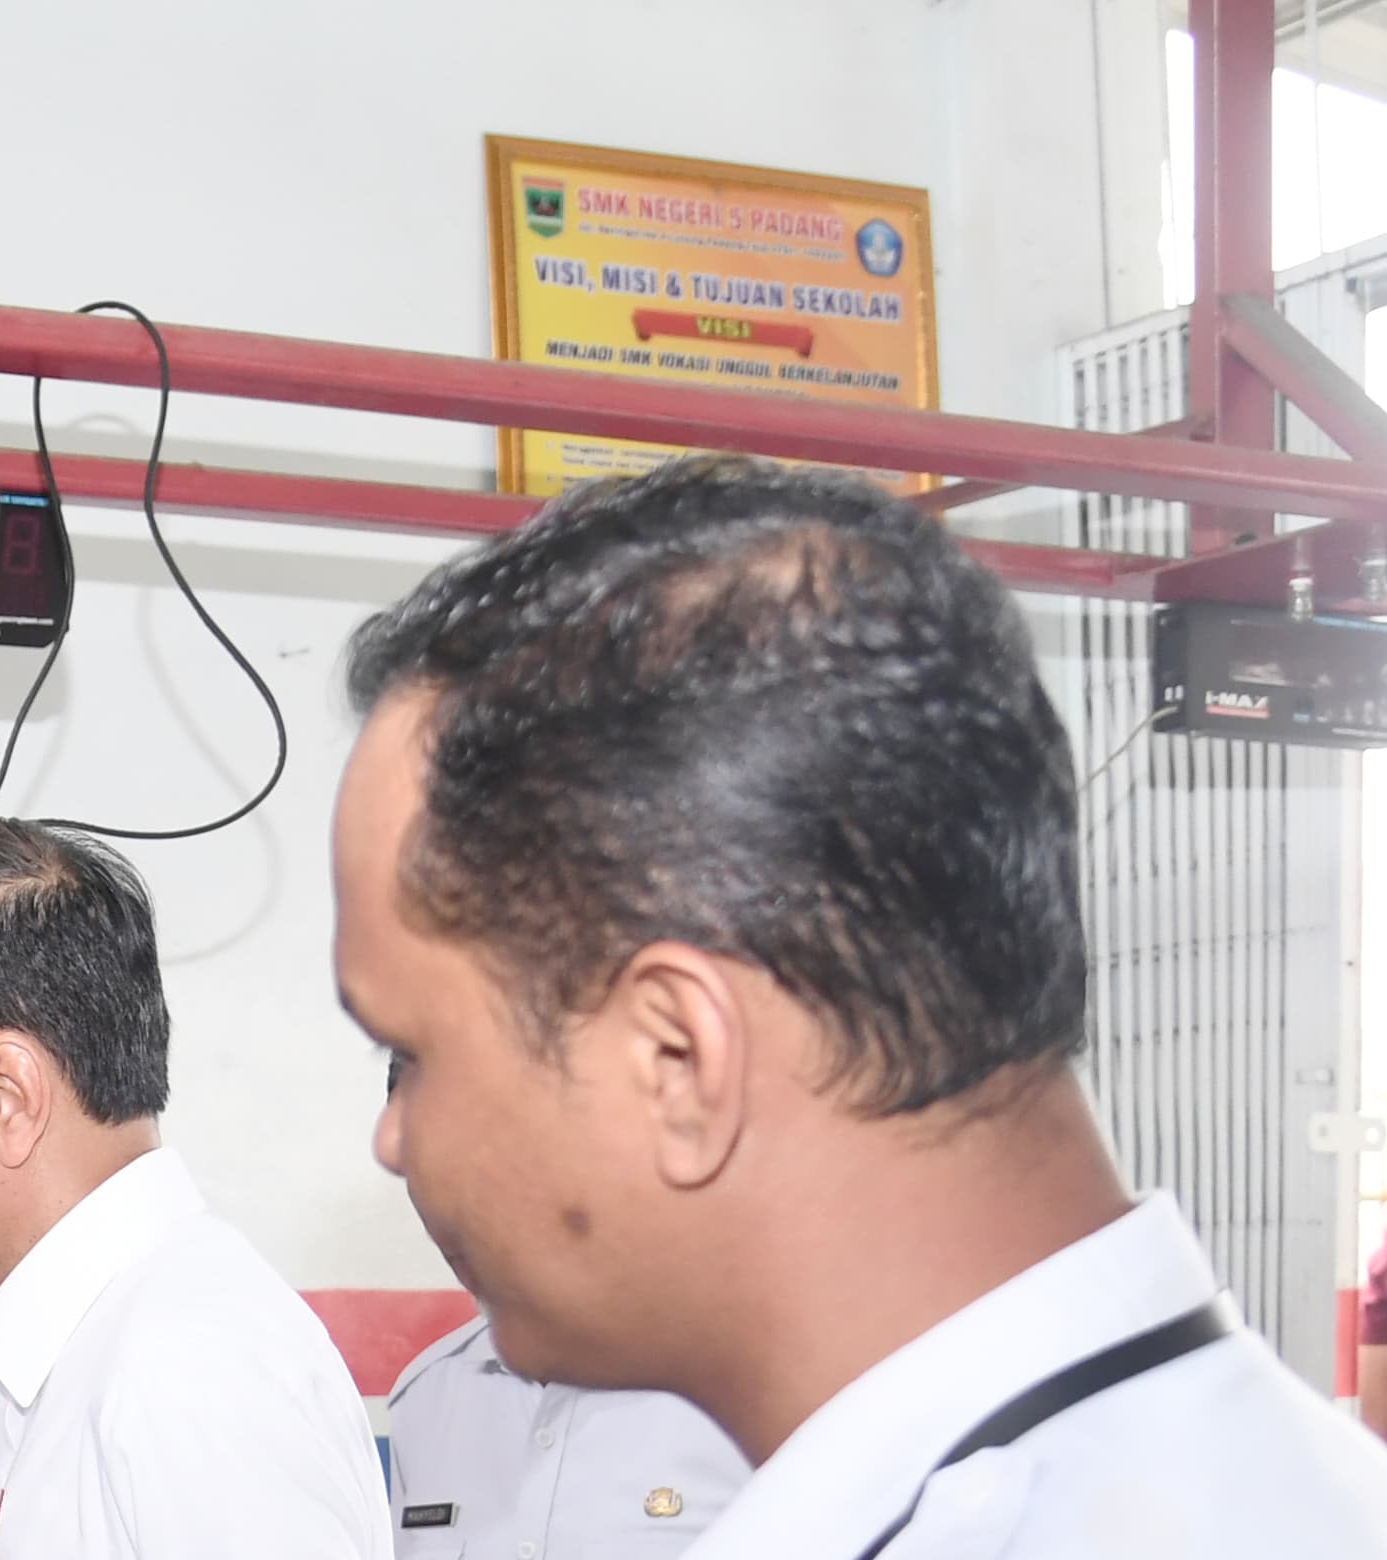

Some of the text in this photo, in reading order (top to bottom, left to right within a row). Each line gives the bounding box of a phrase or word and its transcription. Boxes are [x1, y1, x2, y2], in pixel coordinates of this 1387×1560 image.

[578, 188, 630, 215] SMK
[638, 195, 723, 228] NEGERI
[730, 206, 743, 230] 5
[750, 207, 845, 242] PADANG
[535, 257, 902, 321] VISI, MISI & TUJUAN SEKOLAH
[695, 315, 752, 339] VISI
[546, 340, 613, 362] MENJADI
[656, 353, 711, 372] VOKASI
[778, 364, 900, 391] BERKELANJUTAN
